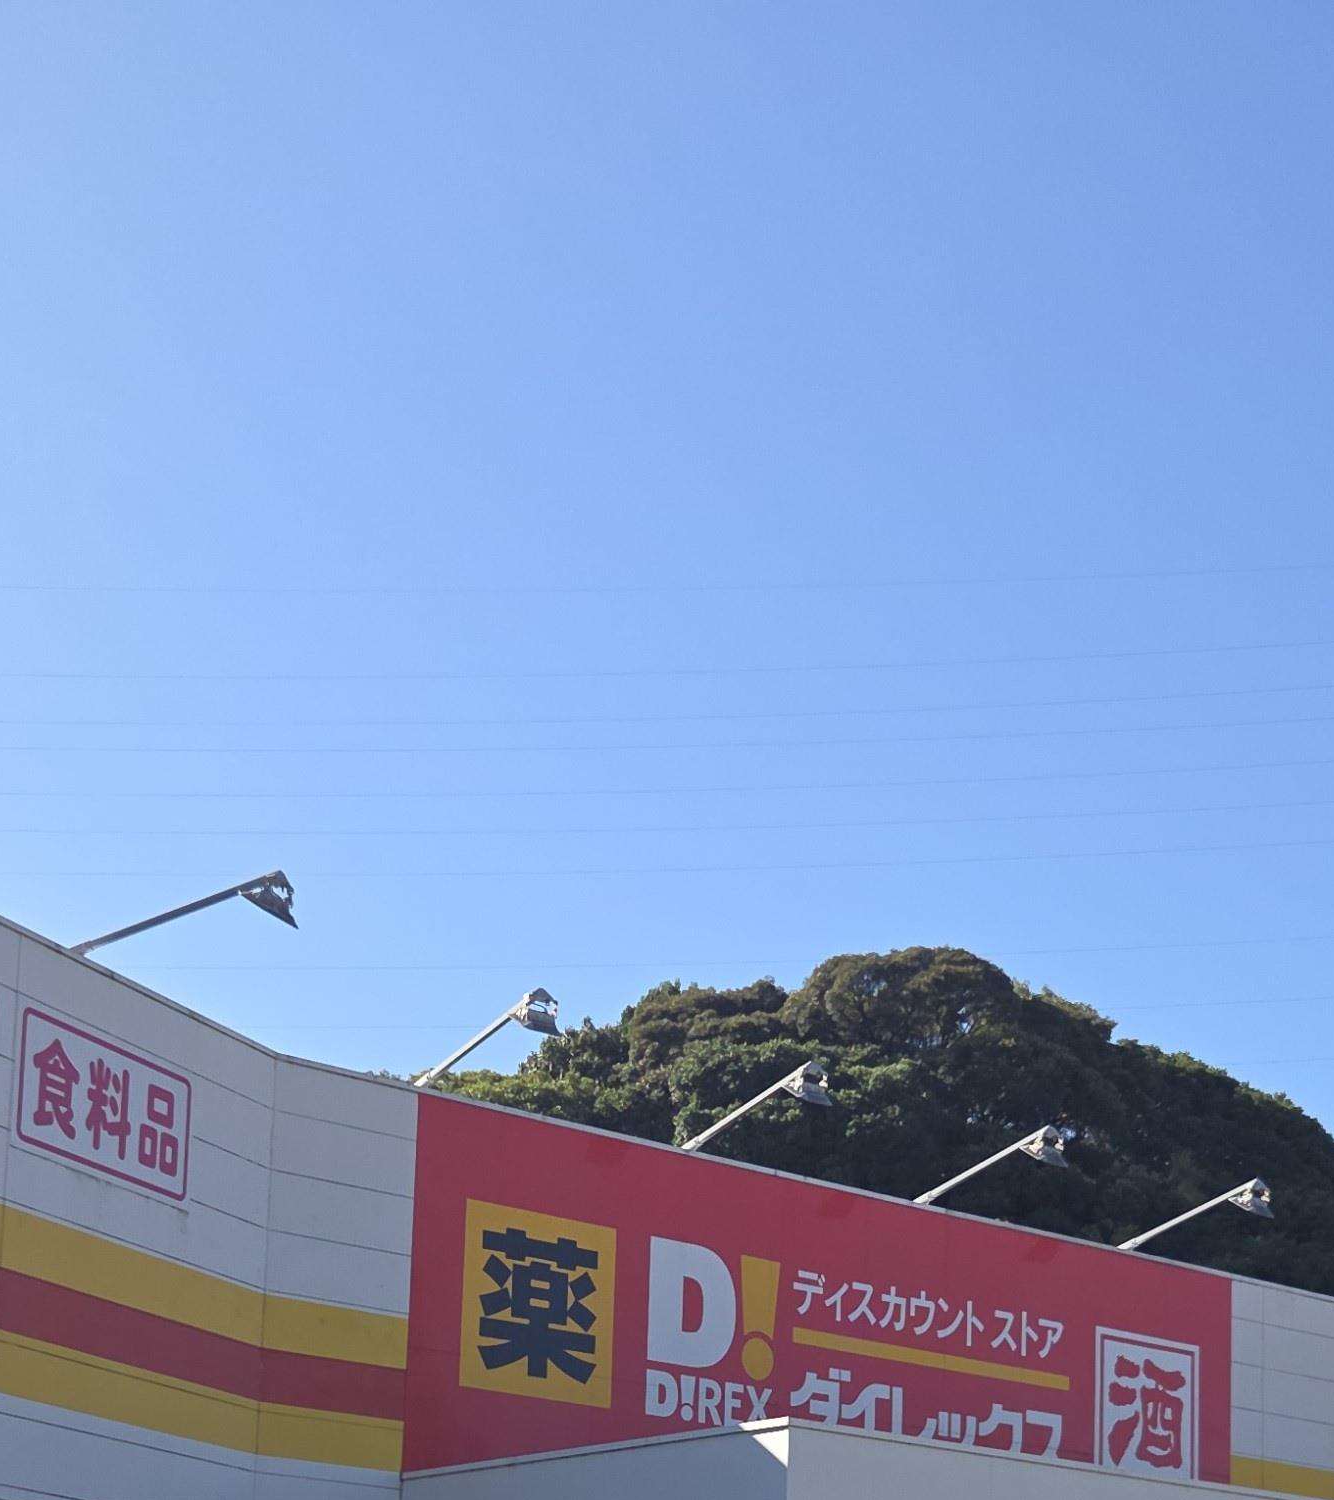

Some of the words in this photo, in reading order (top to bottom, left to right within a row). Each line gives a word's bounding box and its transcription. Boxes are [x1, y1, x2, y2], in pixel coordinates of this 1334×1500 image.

[33, 1039, 178, 1178] 食料品
[479, 1228, 598, 1383] 薬
[792, 1269, 985, 1346] ディスカウント
[991, 1307, 1064, 1358] ストア
[1108, 1353, 1185, 1469] 酒
